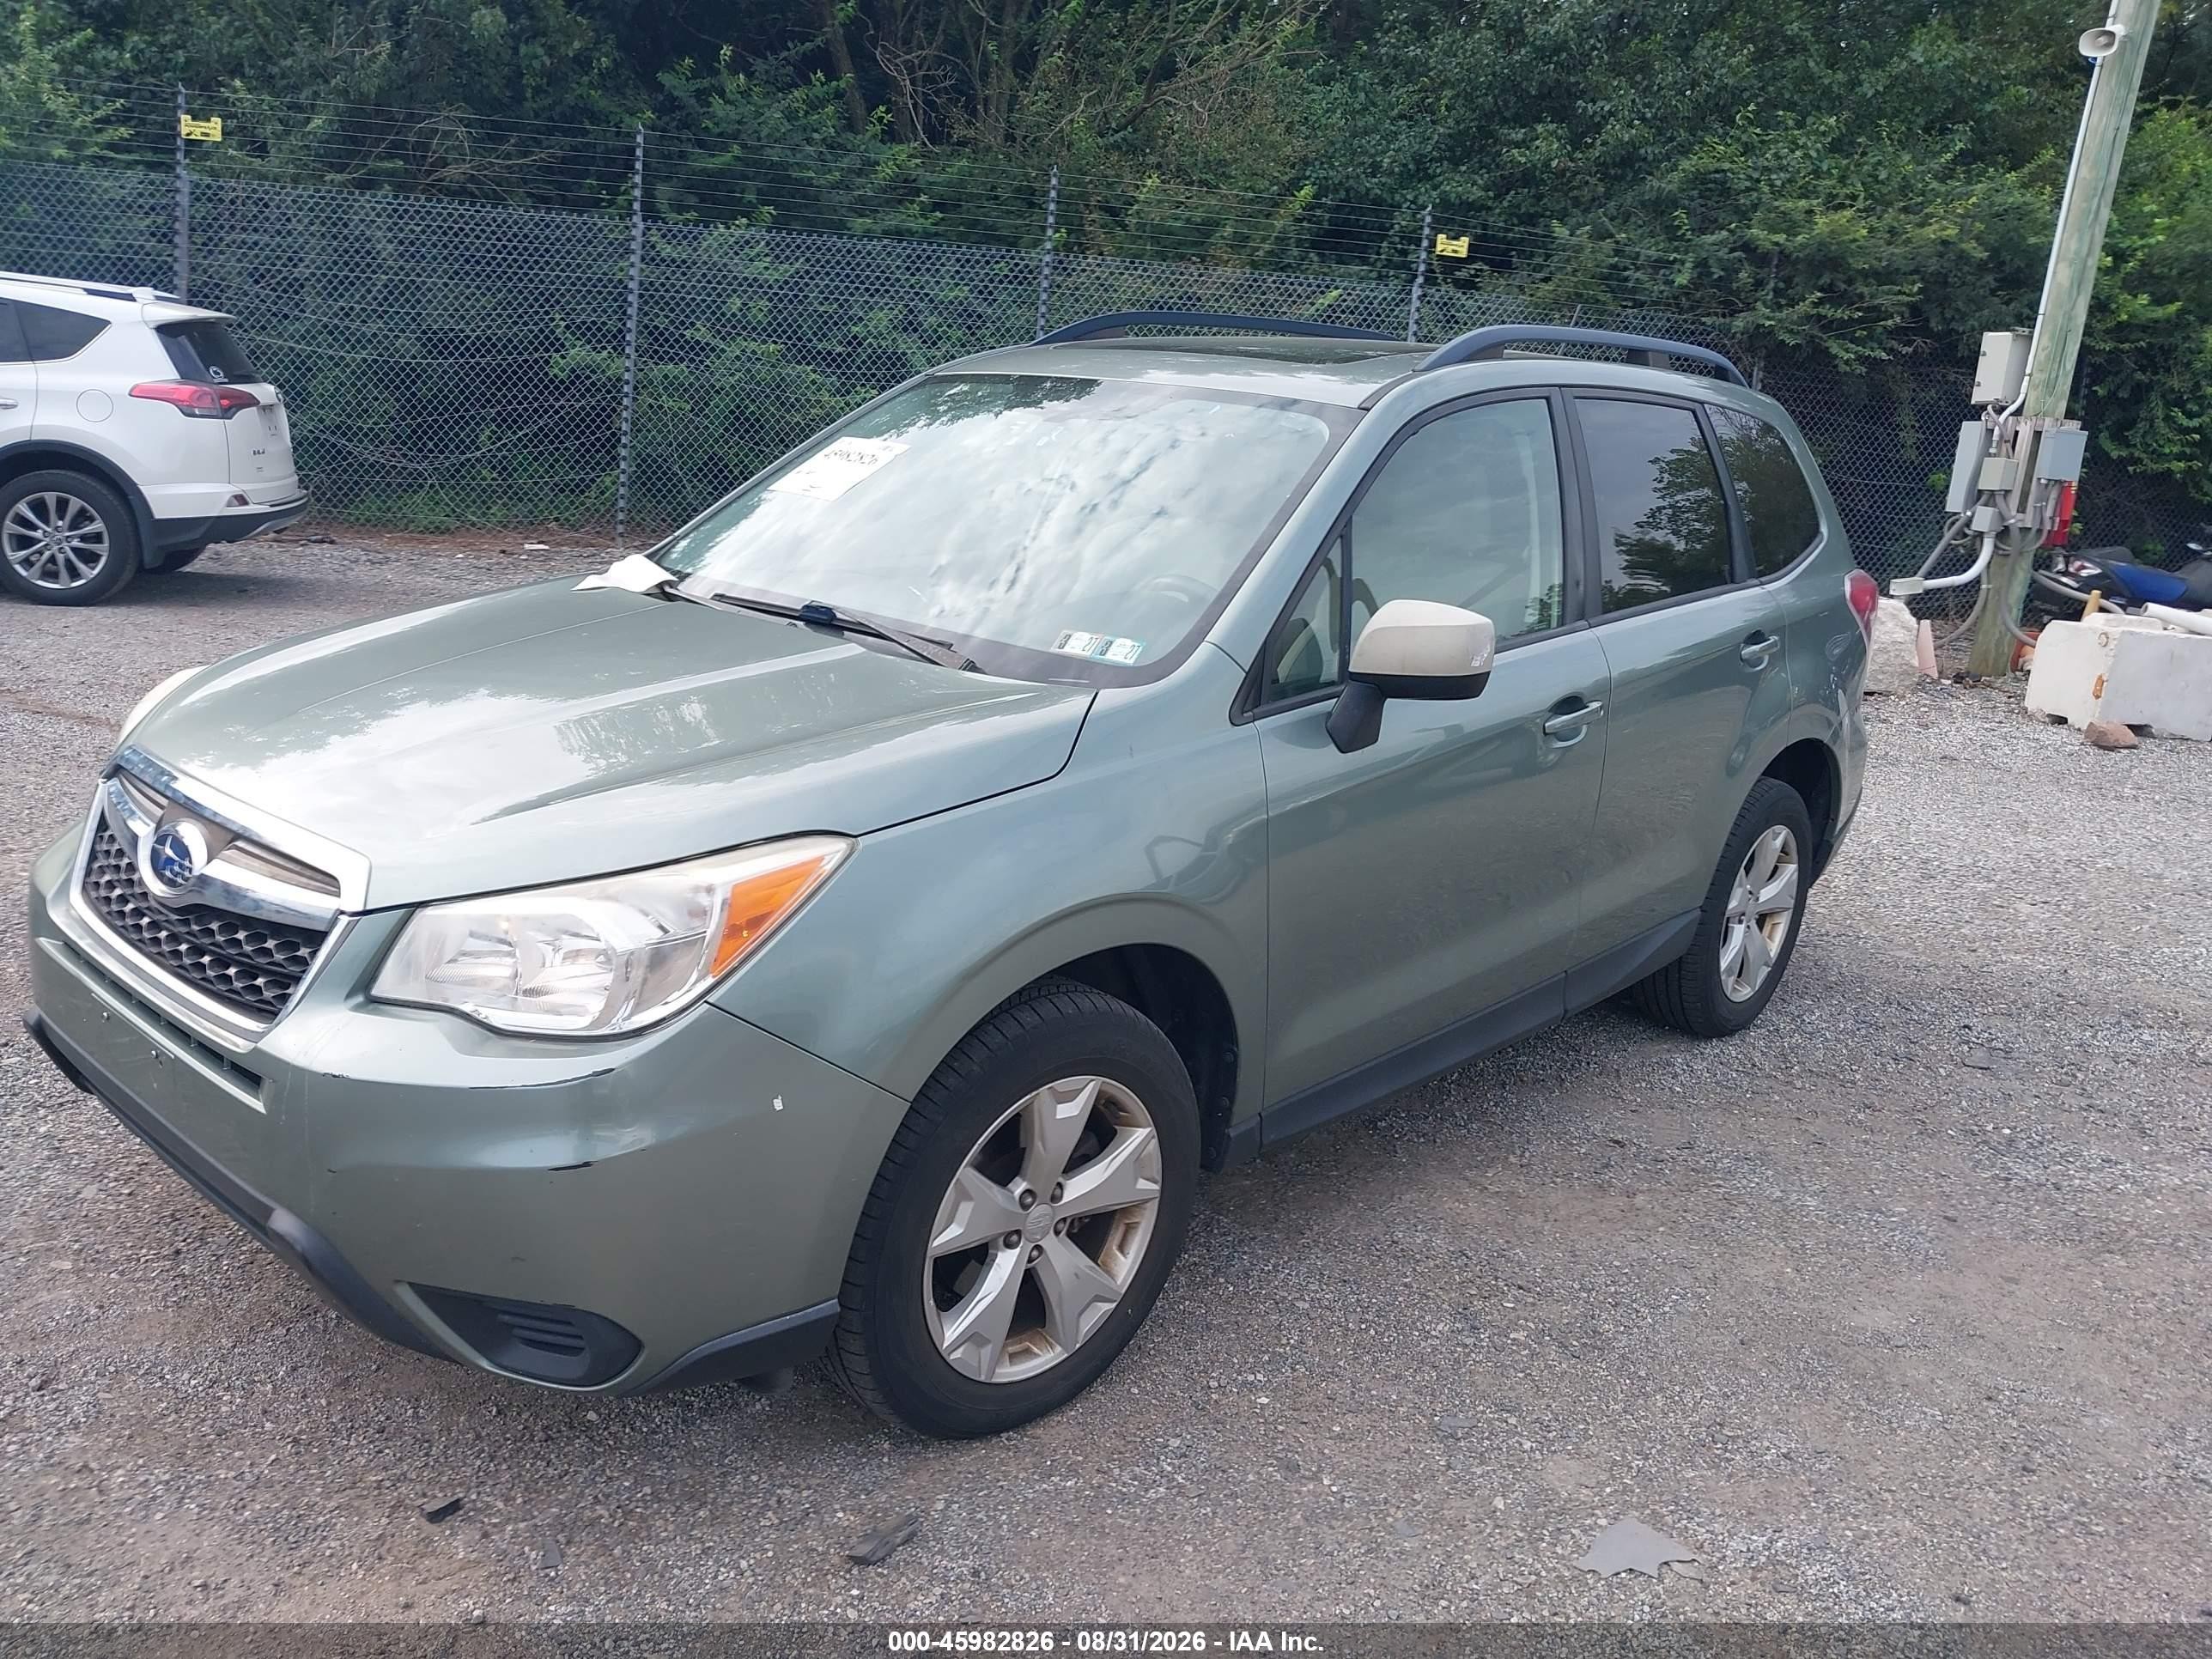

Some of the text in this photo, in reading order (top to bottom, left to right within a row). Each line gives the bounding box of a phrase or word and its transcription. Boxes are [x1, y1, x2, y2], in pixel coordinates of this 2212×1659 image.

[1058, 634, 1098, 653] 3 27
[1099, 640, 1141, 660] 3 27
